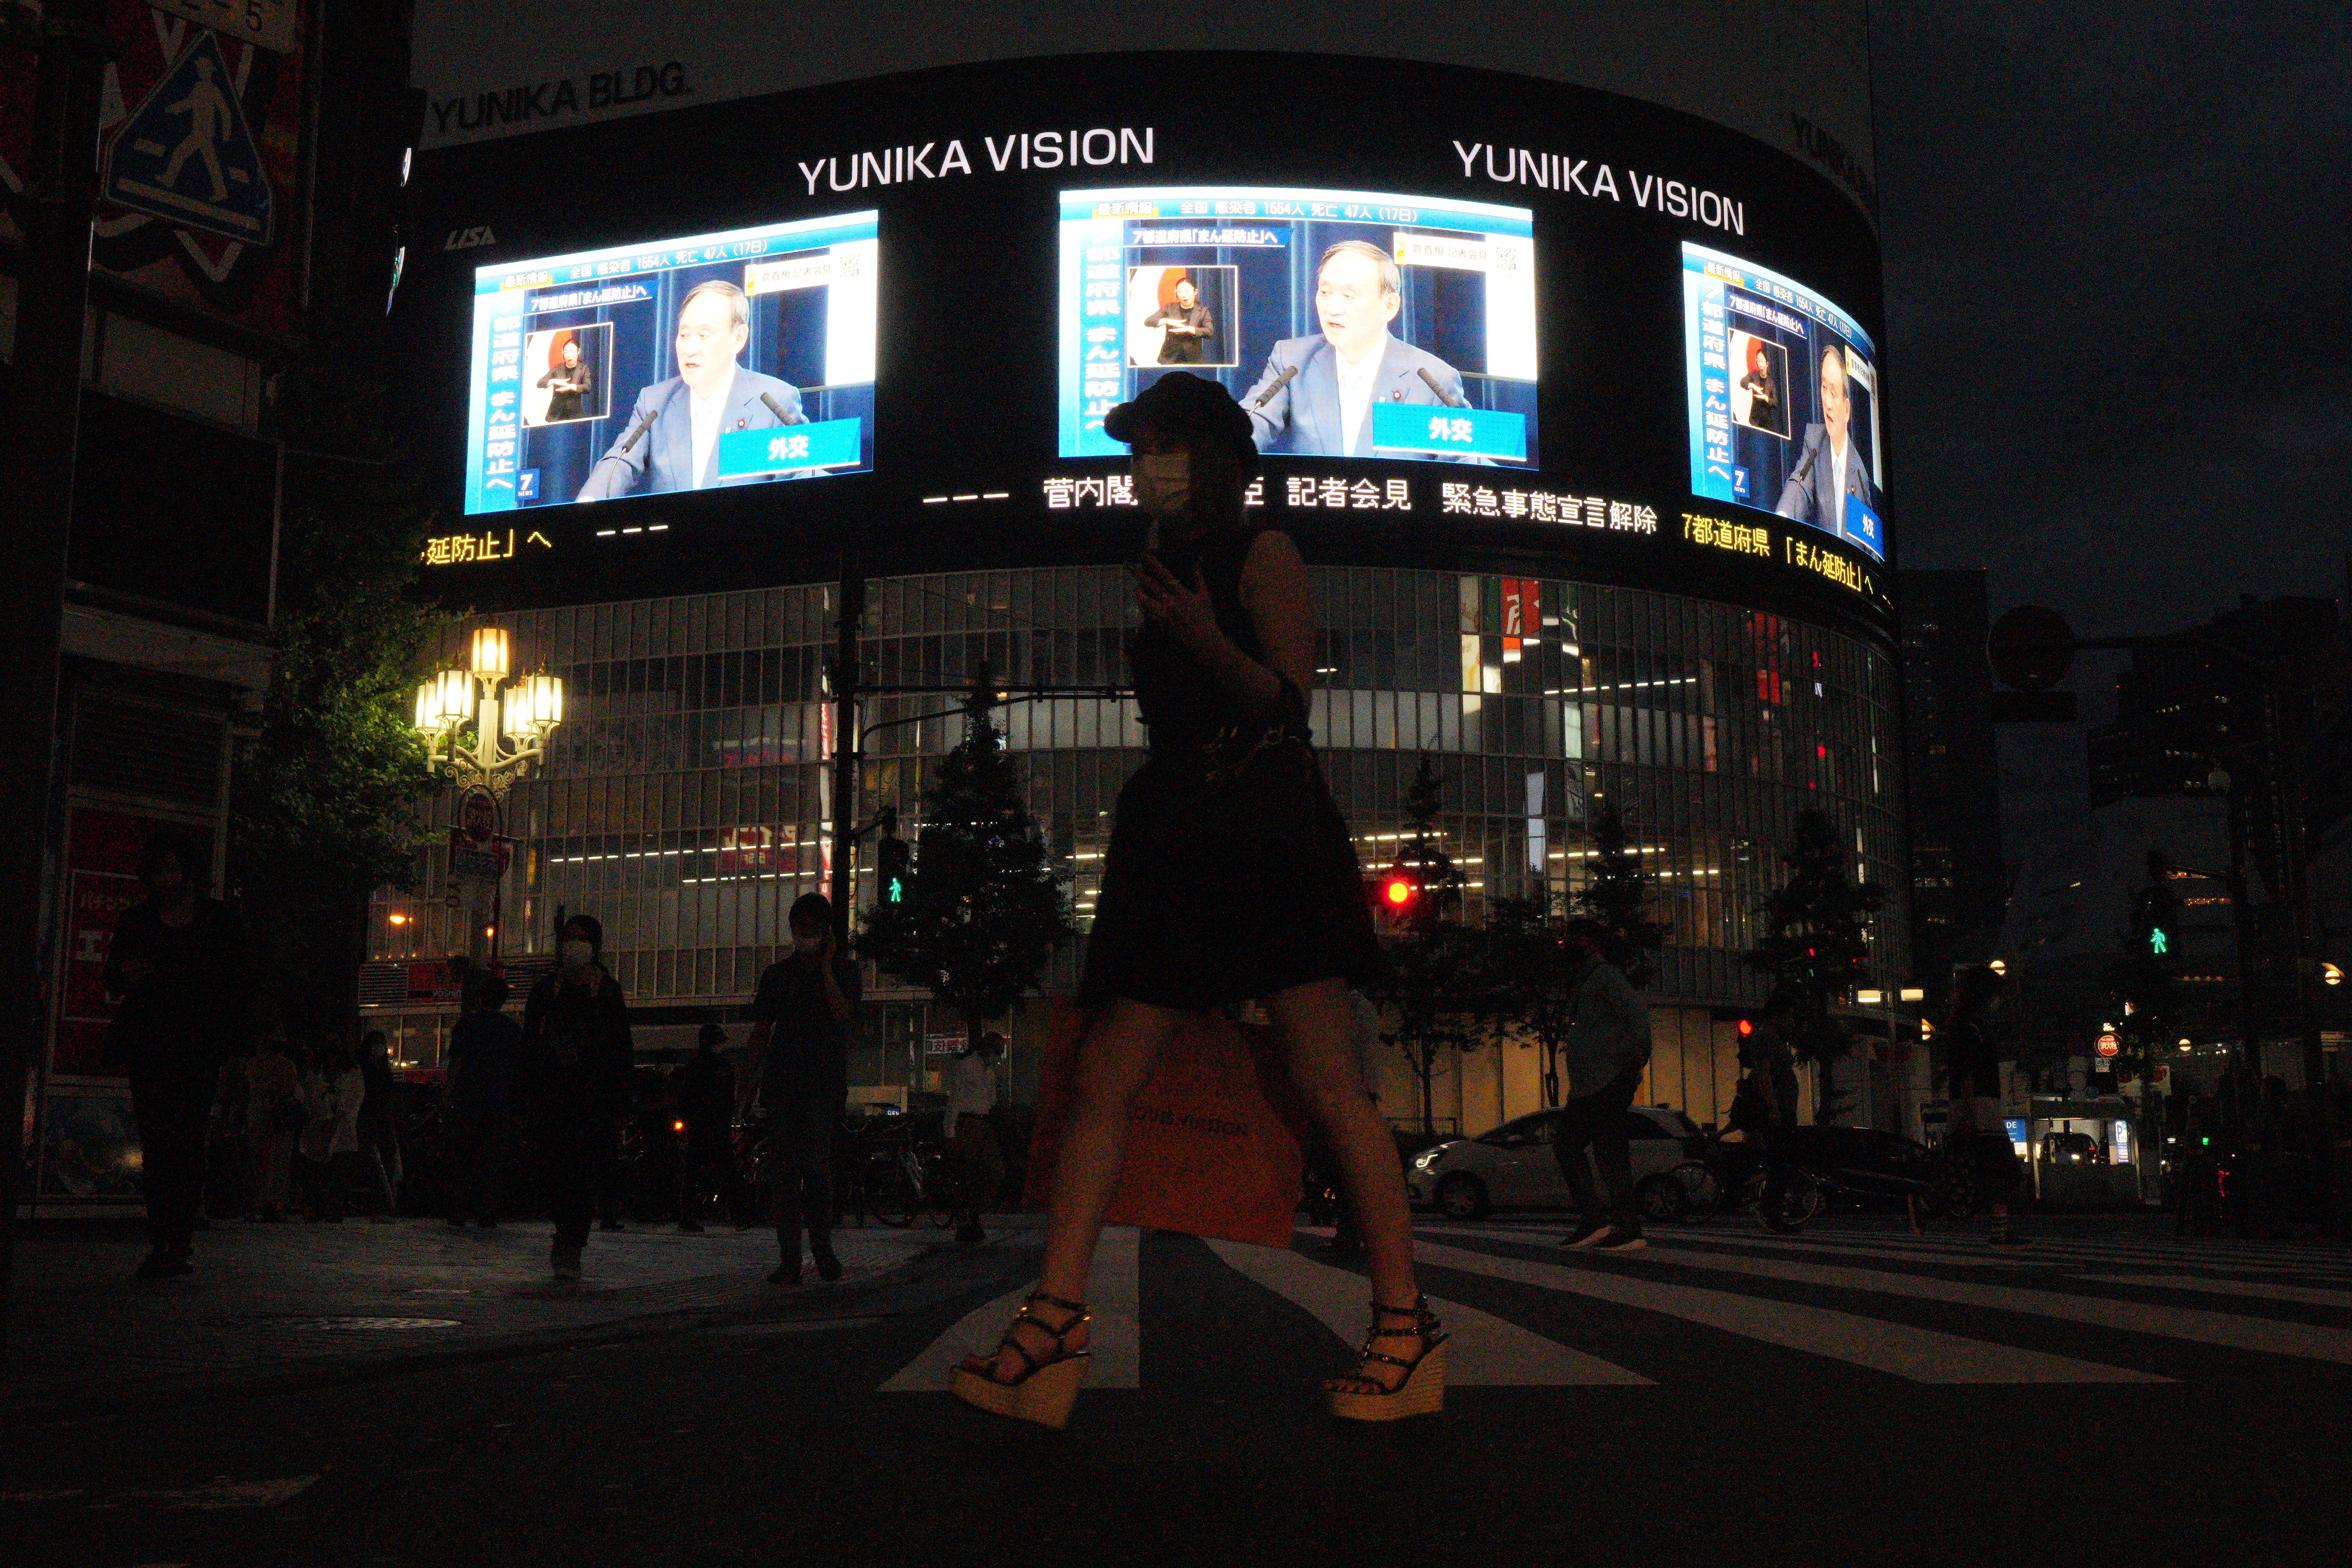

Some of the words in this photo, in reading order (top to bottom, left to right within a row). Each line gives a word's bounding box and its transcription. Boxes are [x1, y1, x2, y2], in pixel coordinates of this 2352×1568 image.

[432, 80, 578, 132] YUNIKA
[590, 62, 693, 109] BLDG.
[798, 140, 972, 196] YUNIKA
[985, 127, 1155, 172] VISION
[1453, 140, 1620, 202] YUNIKA
[1628, 170, 1745, 236] VISION
[1097, 201, 1153, 216] 最新情報
[1180, 201, 1208, 214] 全国
[1214, 201, 1257, 214] 感染者
[1311, 204, 1338, 218] 死亡
[1345, 205, 1372, 219] 47人
[569, 264, 592, 279] 全国
[597, 259, 631, 276] 感染者
[675, 251, 699, 264] 死亡
[704, 246, 728, 260] 47人
[1755, 278, 1770, 294] 全国
[1773, 285, 1793, 303] 感染者
[1815, 305, 1826, 321] 死亡
[1828, 313, 1838, 329] 47人
[486, 392, 517, 488] まん延防止へ
[768, 435, 809, 461] 外交
[1429, 417, 1472, 442] 外交
[1705, 378, 1730, 480] まん延防止へ
[520, 474, 533, 490] 7
[1734, 470, 1744, 486] 7
[1287, 477, 1411, 510] 記者会見
[1442, 483, 1657, 535] 緊急事態宣言解除
[1682, 514, 1770, 557] 7都道府県
[1863, 514, 1874, 539] 外交
[421, 529, 551, 564] 延防止」へ
